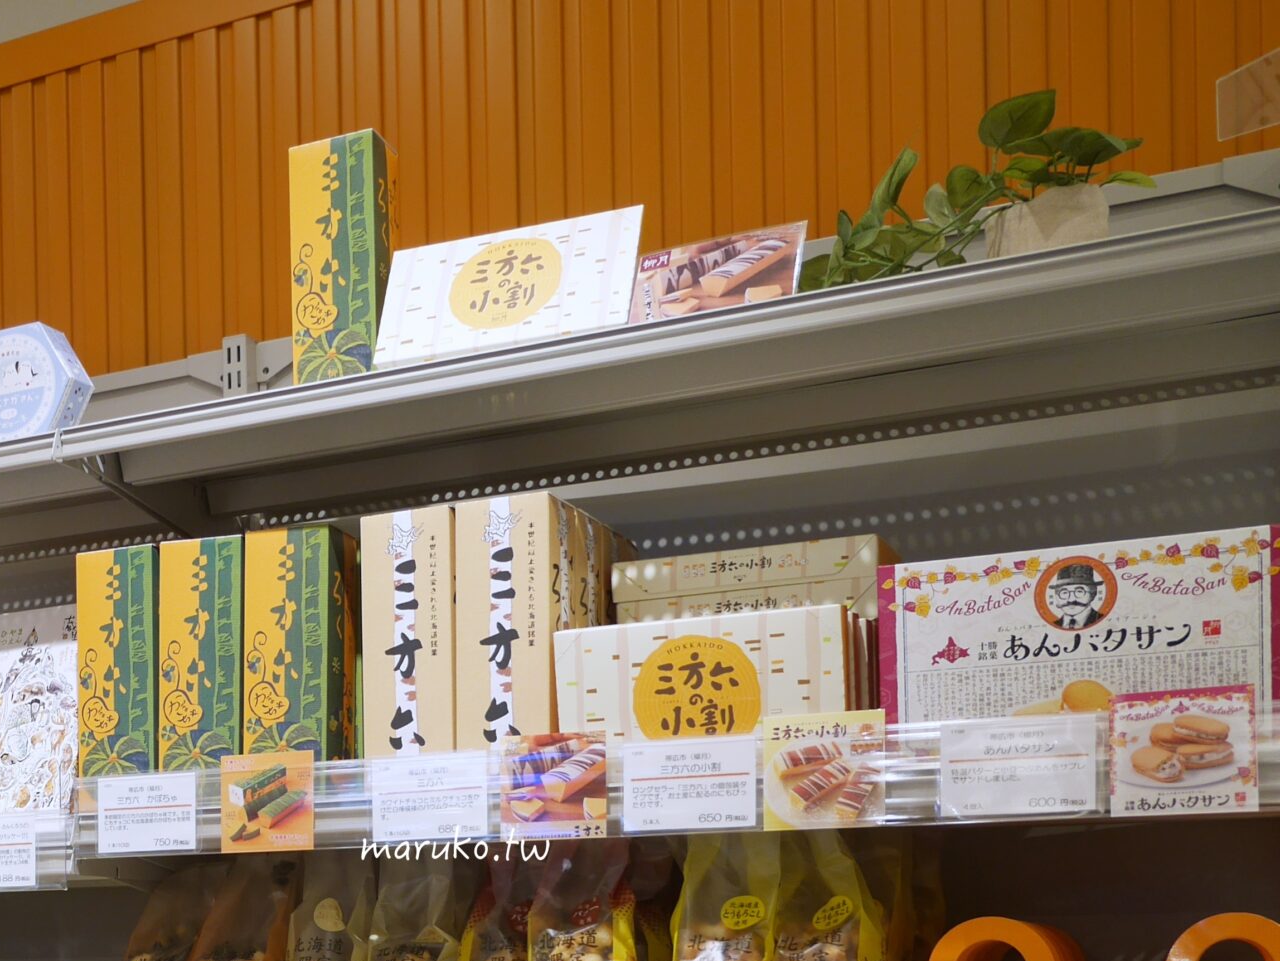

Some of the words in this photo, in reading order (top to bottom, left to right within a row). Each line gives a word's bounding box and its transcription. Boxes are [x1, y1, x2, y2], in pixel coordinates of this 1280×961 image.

[470, 249, 545, 285] 三方六
[470, 283, 536, 314] 小割
[709, 554, 773, 575] 三方六の小割
[1121, 571, 1228, 596] AnBataSan
[270, 543, 300, 679] 三方六
[714, 597, 778, 614] 三方六の小割
[935, 581, 1032, 616] AnBataSan
[99, 564, 128, 695] 三方六
[184, 554, 212, 688] 三方六
[385, 559, 426, 750] 三方六
[479, 546, 521, 743] 三方六
[666, 641, 724, 657] HOKKAIDO
[1003, 623, 1192, 661] あんバタサン
[654, 651, 740, 696] 三方六
[660, 698, 735, 737] 小割
[770, 722, 847, 743] 三方六の小割
[982, 743, 1055, 756] あんバタサン
[660, 762, 722, 775] 三方六の小割
[1028, 797, 1057, 808] 600
[1137, 791, 1232, 811] あんバタサン
[698, 813, 723, 824] 650
[153, 838, 171, 847] 750
[539, 930, 598, 950] 北海道
